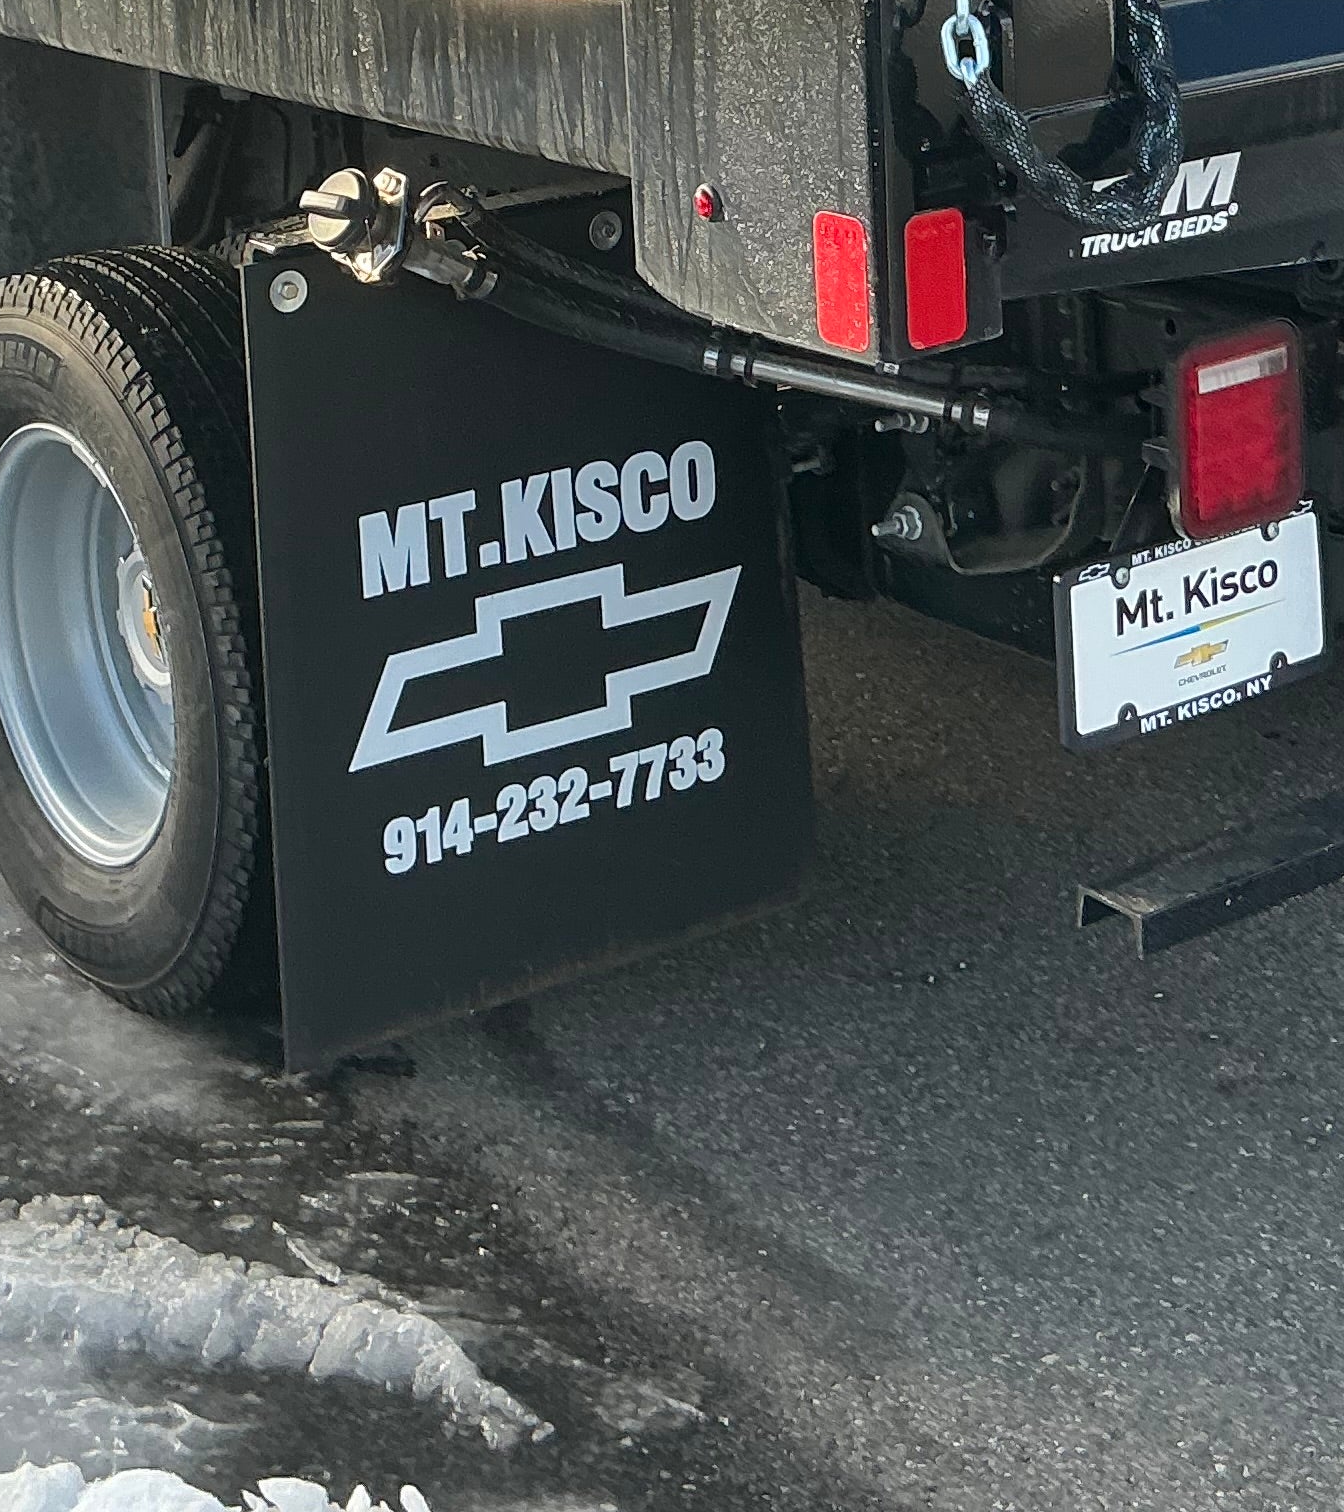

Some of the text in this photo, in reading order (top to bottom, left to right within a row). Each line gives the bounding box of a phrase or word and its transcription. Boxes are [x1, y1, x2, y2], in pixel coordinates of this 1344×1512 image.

[1080, 221, 1161, 258] TRUCK
[1131, 538, 1192, 566] MT. KISCO
[1115, 559, 1278, 637] Mt. Kisco
[1140, 674, 1273, 735] MT. KISCO, NY
[382, 727, 726, 875] 914-232-7733
